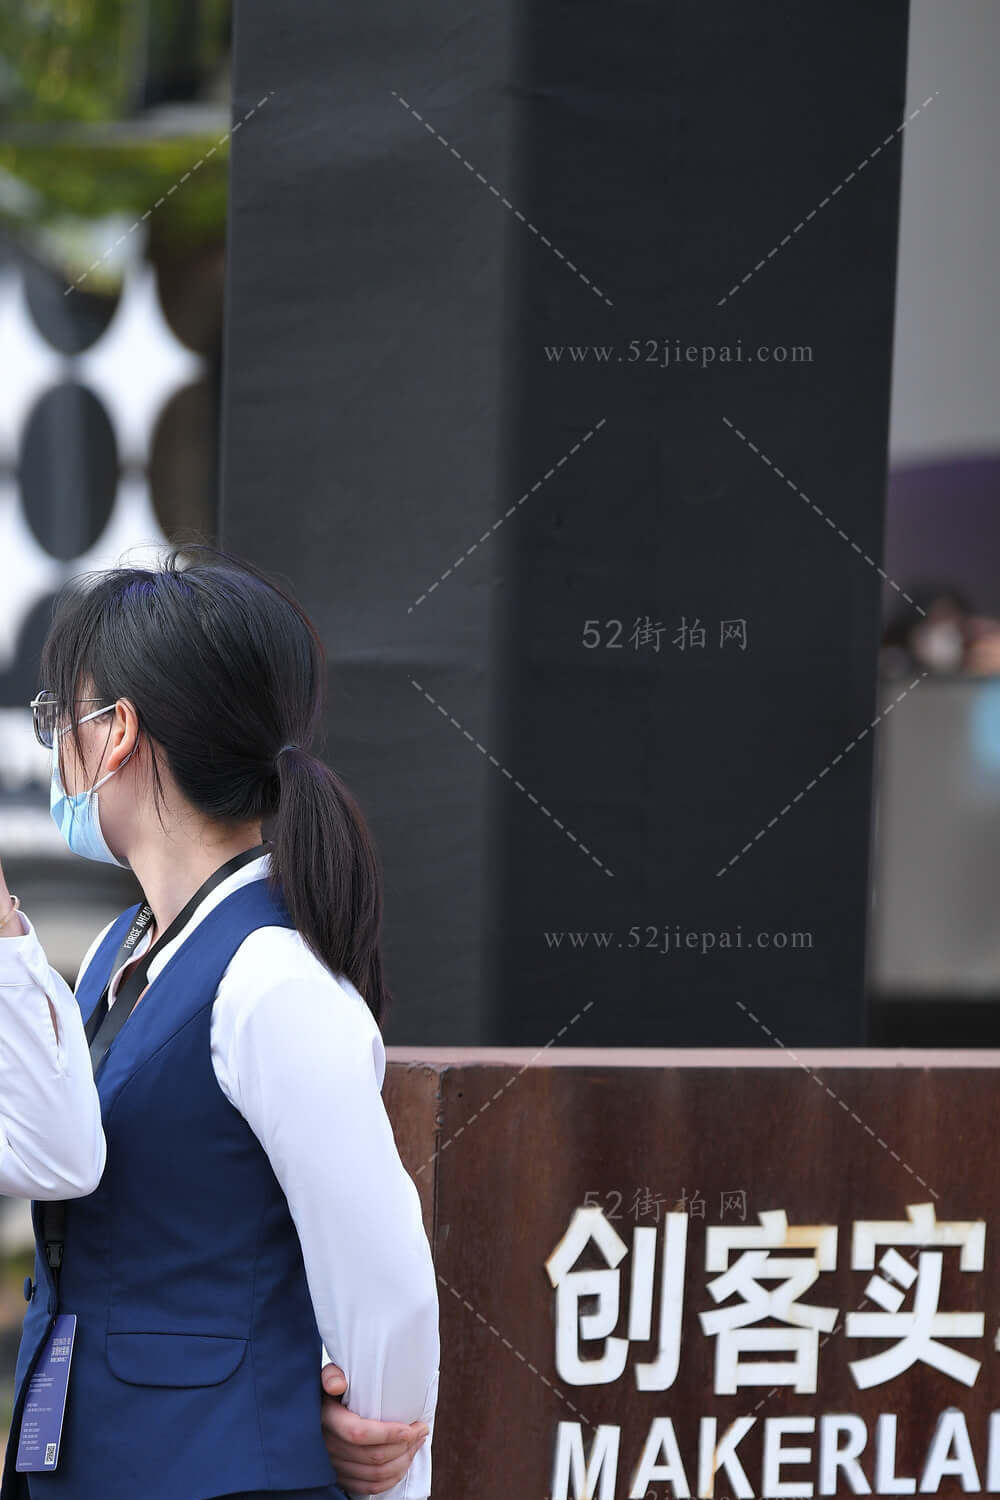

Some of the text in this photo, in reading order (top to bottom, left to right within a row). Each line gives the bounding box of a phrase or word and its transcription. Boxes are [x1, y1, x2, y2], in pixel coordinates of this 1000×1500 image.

[123, 927, 142, 949] FORGE
[544, 1202, 1000, 1394] 创客实
